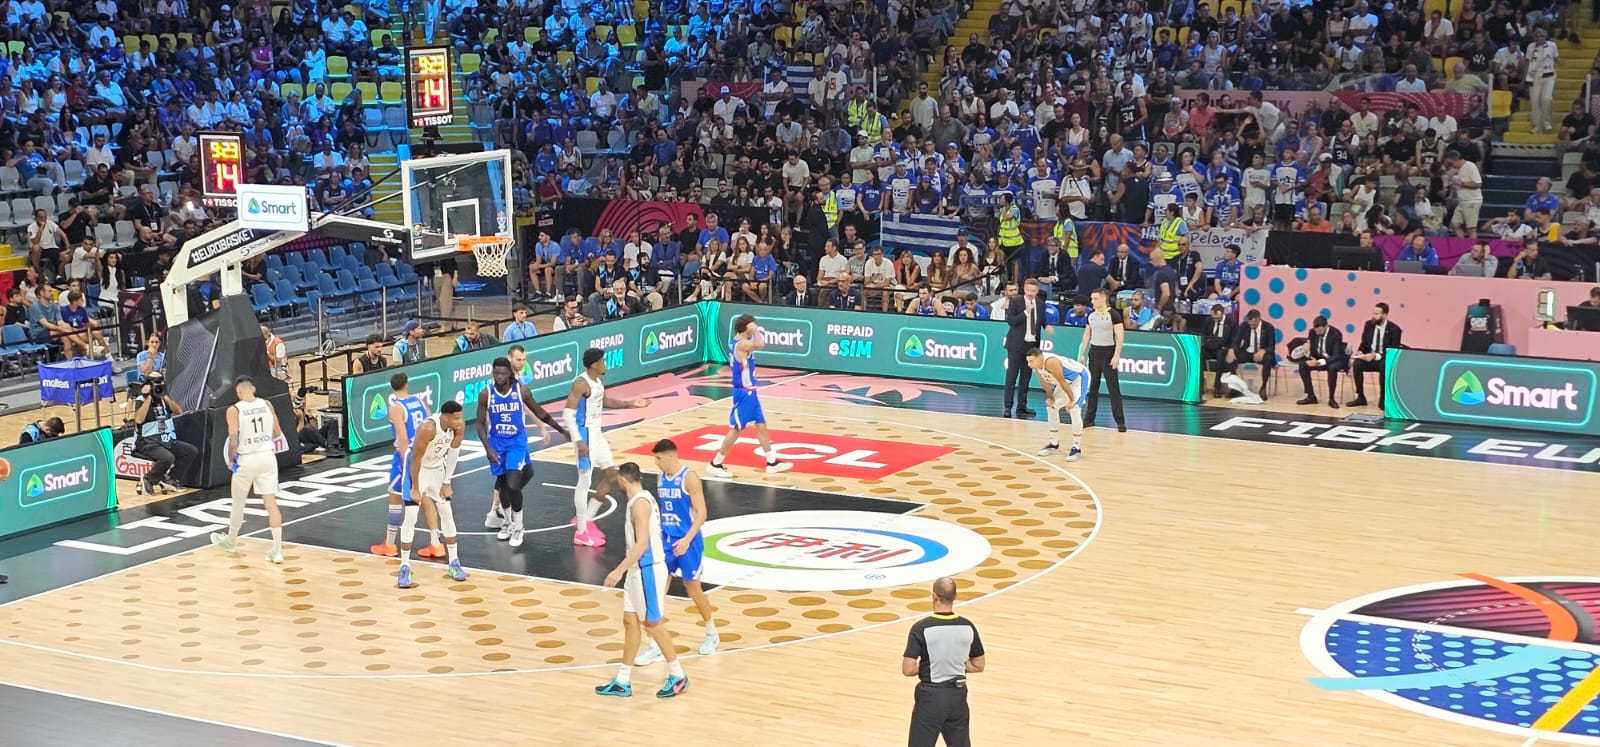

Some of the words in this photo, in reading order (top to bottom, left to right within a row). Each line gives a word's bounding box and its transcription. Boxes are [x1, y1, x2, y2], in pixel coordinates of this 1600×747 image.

[424, 78, 444, 107] 14
[425, 115, 453, 126] TISSOT
[216, 163, 239, 190] 14
[214, 198, 238, 207] TISSO
[261, 200, 297, 214] Smart
[191, 228, 255, 264] #EUROBASKET
[1190, 231, 1246, 248] Pelargoi
[659, 325, 693, 350] Smart
[826, 324, 874, 338] PREPAID
[590, 333, 624, 349] PREPAID
[828, 339, 873, 358] eSIM
[925, 338, 977, 361] Smart
[453, 363, 493, 382] PREPAID
[533, 353, 573, 380] Smart
[1117, 356, 1167, 375] mart
[1486, 377, 1579, 411] Smart
[490, 402, 520, 413] ITALIA
[251, 416, 264, 433] 11
[500, 413, 511, 422] 35
[1209, 416, 1453, 450] FIBA
[1466, 438, 1600, 464] EU
[693, 433, 889, 469] TCL
[44, 465, 89, 492] Smart
[728, 532, 913, 564] 伊利
